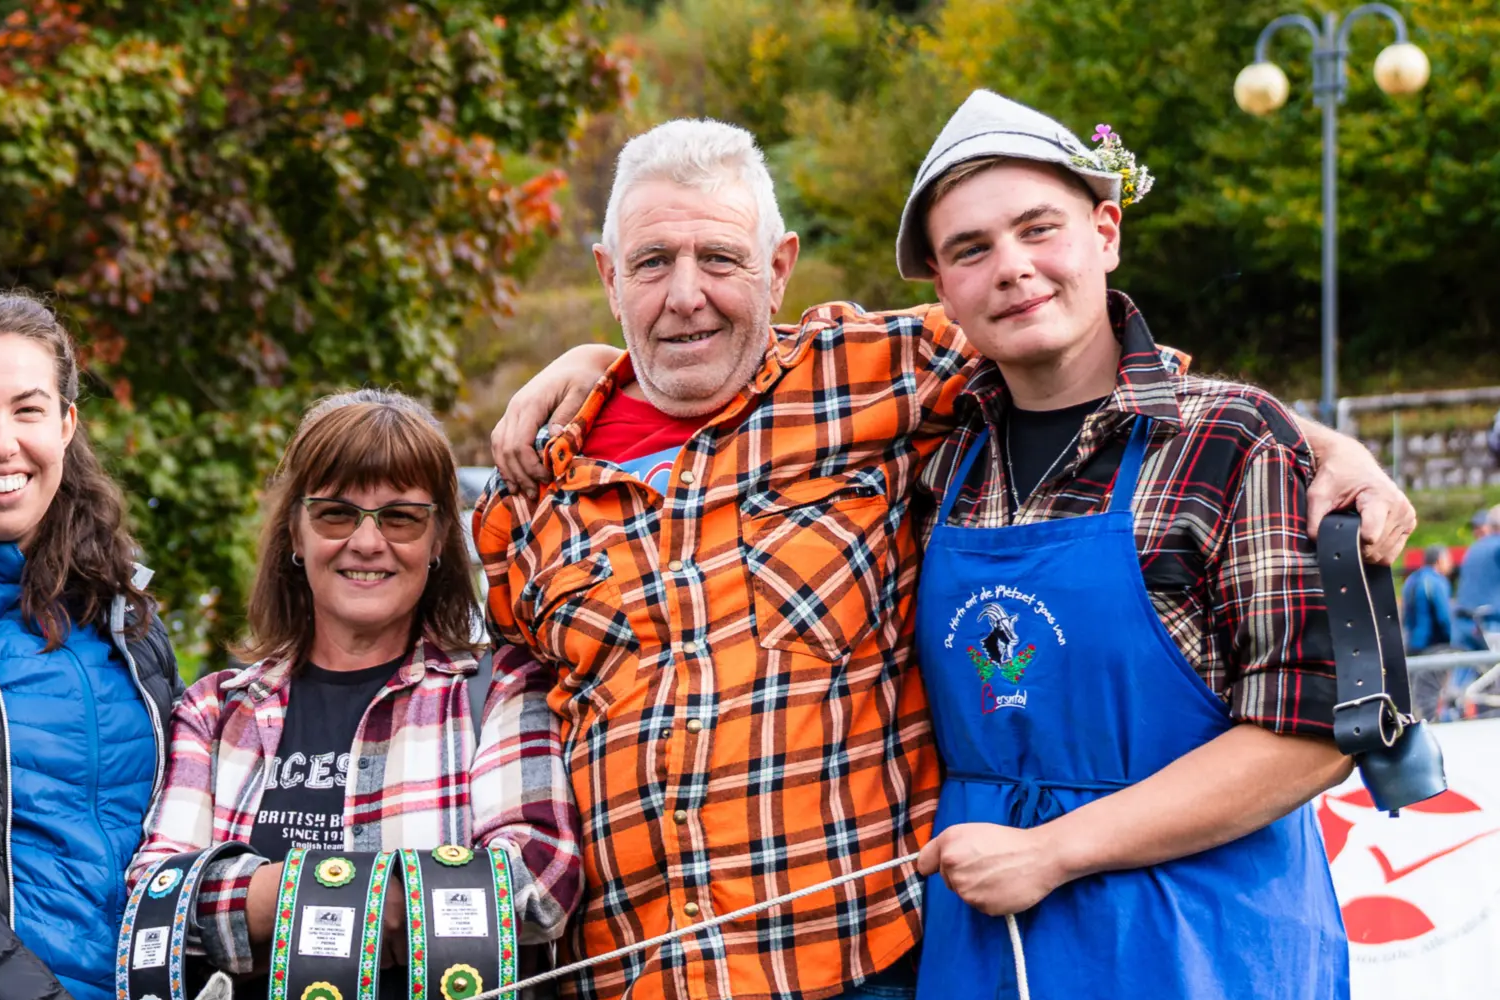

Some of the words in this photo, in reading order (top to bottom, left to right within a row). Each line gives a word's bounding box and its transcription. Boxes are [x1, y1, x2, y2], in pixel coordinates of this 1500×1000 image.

[980, 586, 994, 601] de
[1053, 624, 1066, 646] van
[258, 811, 326, 828] BRITISH
[330, 814, 345, 828] B
[282, 827, 320, 841] SINCE
[291, 840, 322, 850] English
